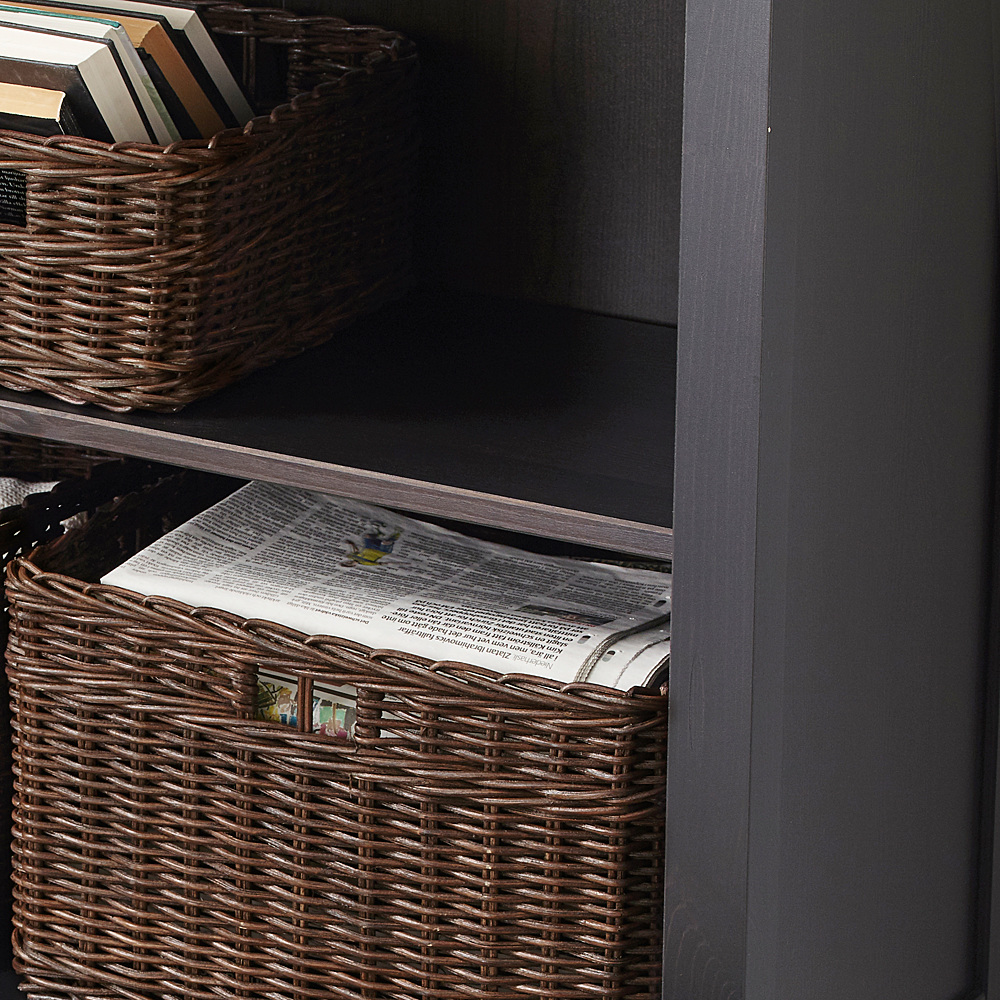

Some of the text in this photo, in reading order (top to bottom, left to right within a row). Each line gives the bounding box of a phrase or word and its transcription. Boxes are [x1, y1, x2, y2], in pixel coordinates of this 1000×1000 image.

[397, 627, 435, 640] fullträffar
[428, 625, 448, 635] hade
[472, 629, 491, 637] fram
[492, 627, 535, 639] schweizisk
[435, 635, 486, 653] Ibrahimovics
[491, 640, 508, 648] vem
[507, 637, 546, 650] Källström
[546, 639, 568, 647] slagit
[486, 648, 512, 659] Zlatan
[509, 645, 528, 653] men
[546, 646, 563, 654] Kim
